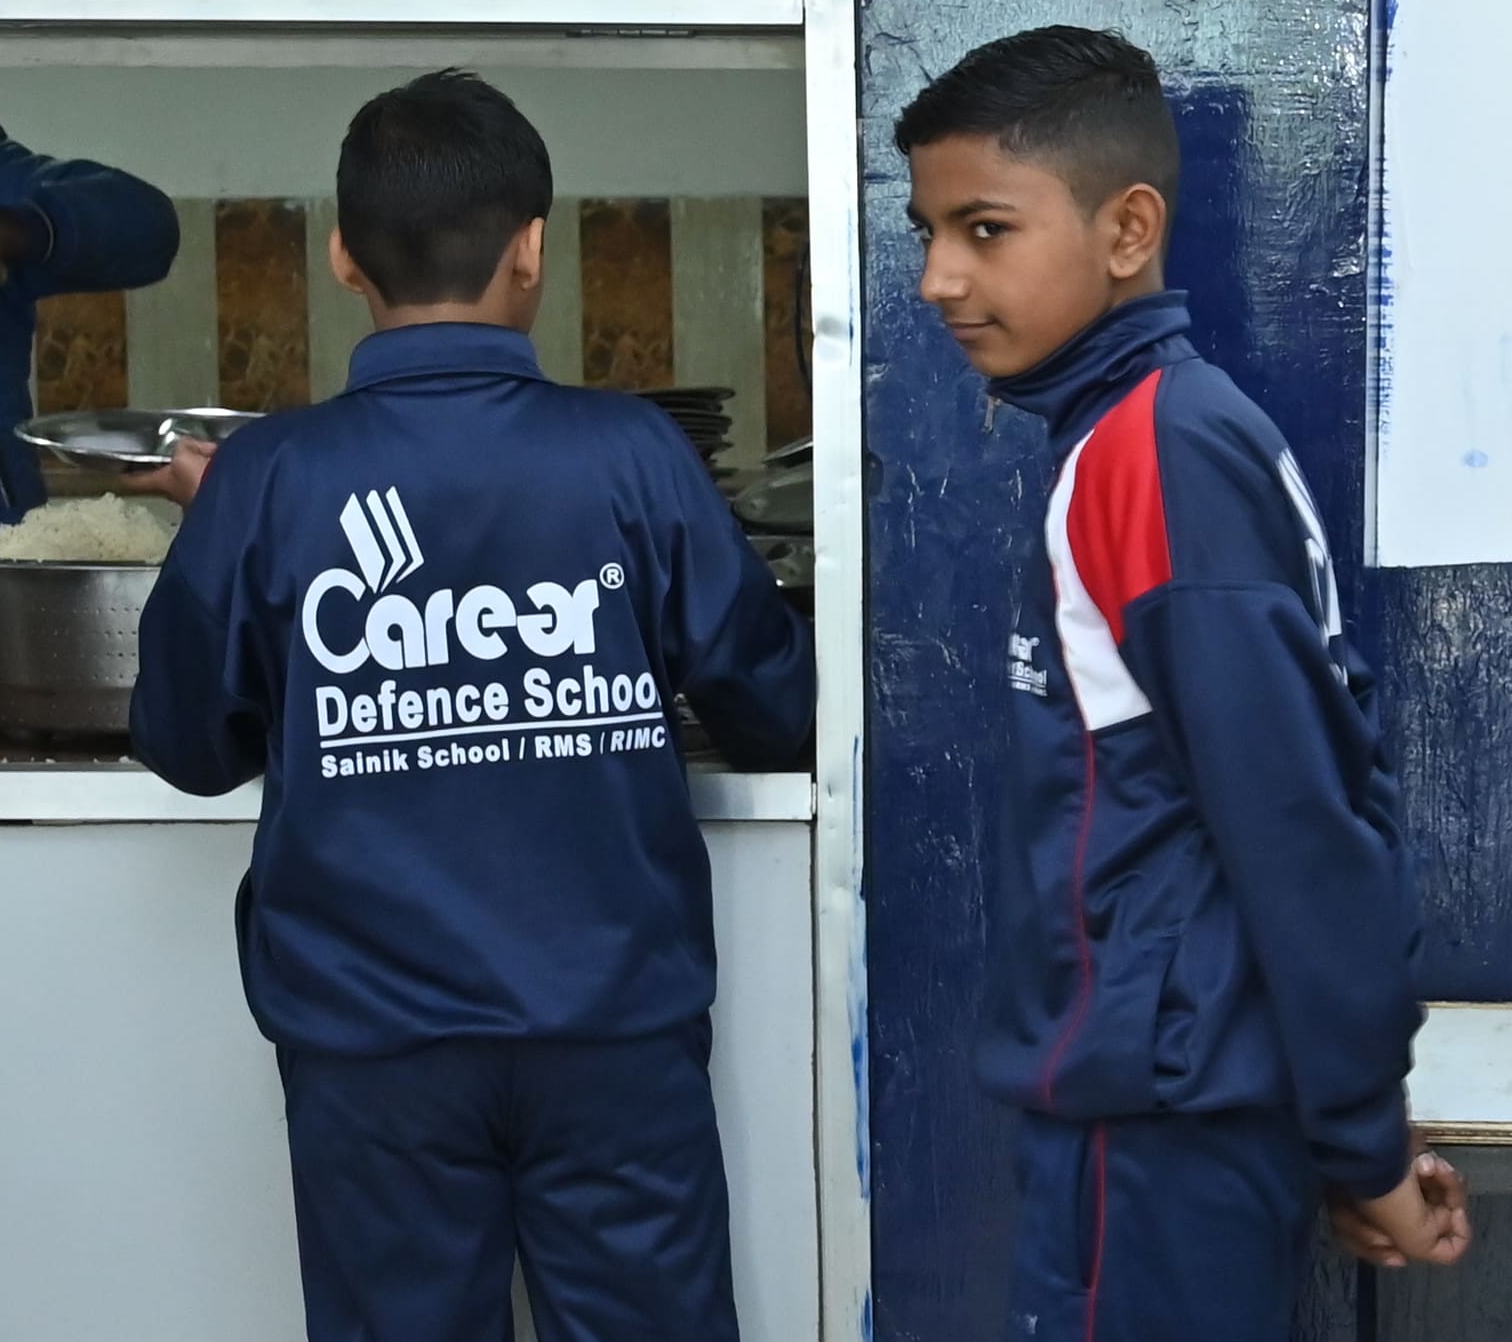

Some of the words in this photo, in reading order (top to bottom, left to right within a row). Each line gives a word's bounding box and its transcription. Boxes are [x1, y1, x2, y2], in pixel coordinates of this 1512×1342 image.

[316, 680, 509, 736] Defence
[321, 748, 409, 778] Sainik
[417, 738, 510, 769] School
[535, 734, 592, 758] RMS
[610, 726, 666, 751] RIMC
